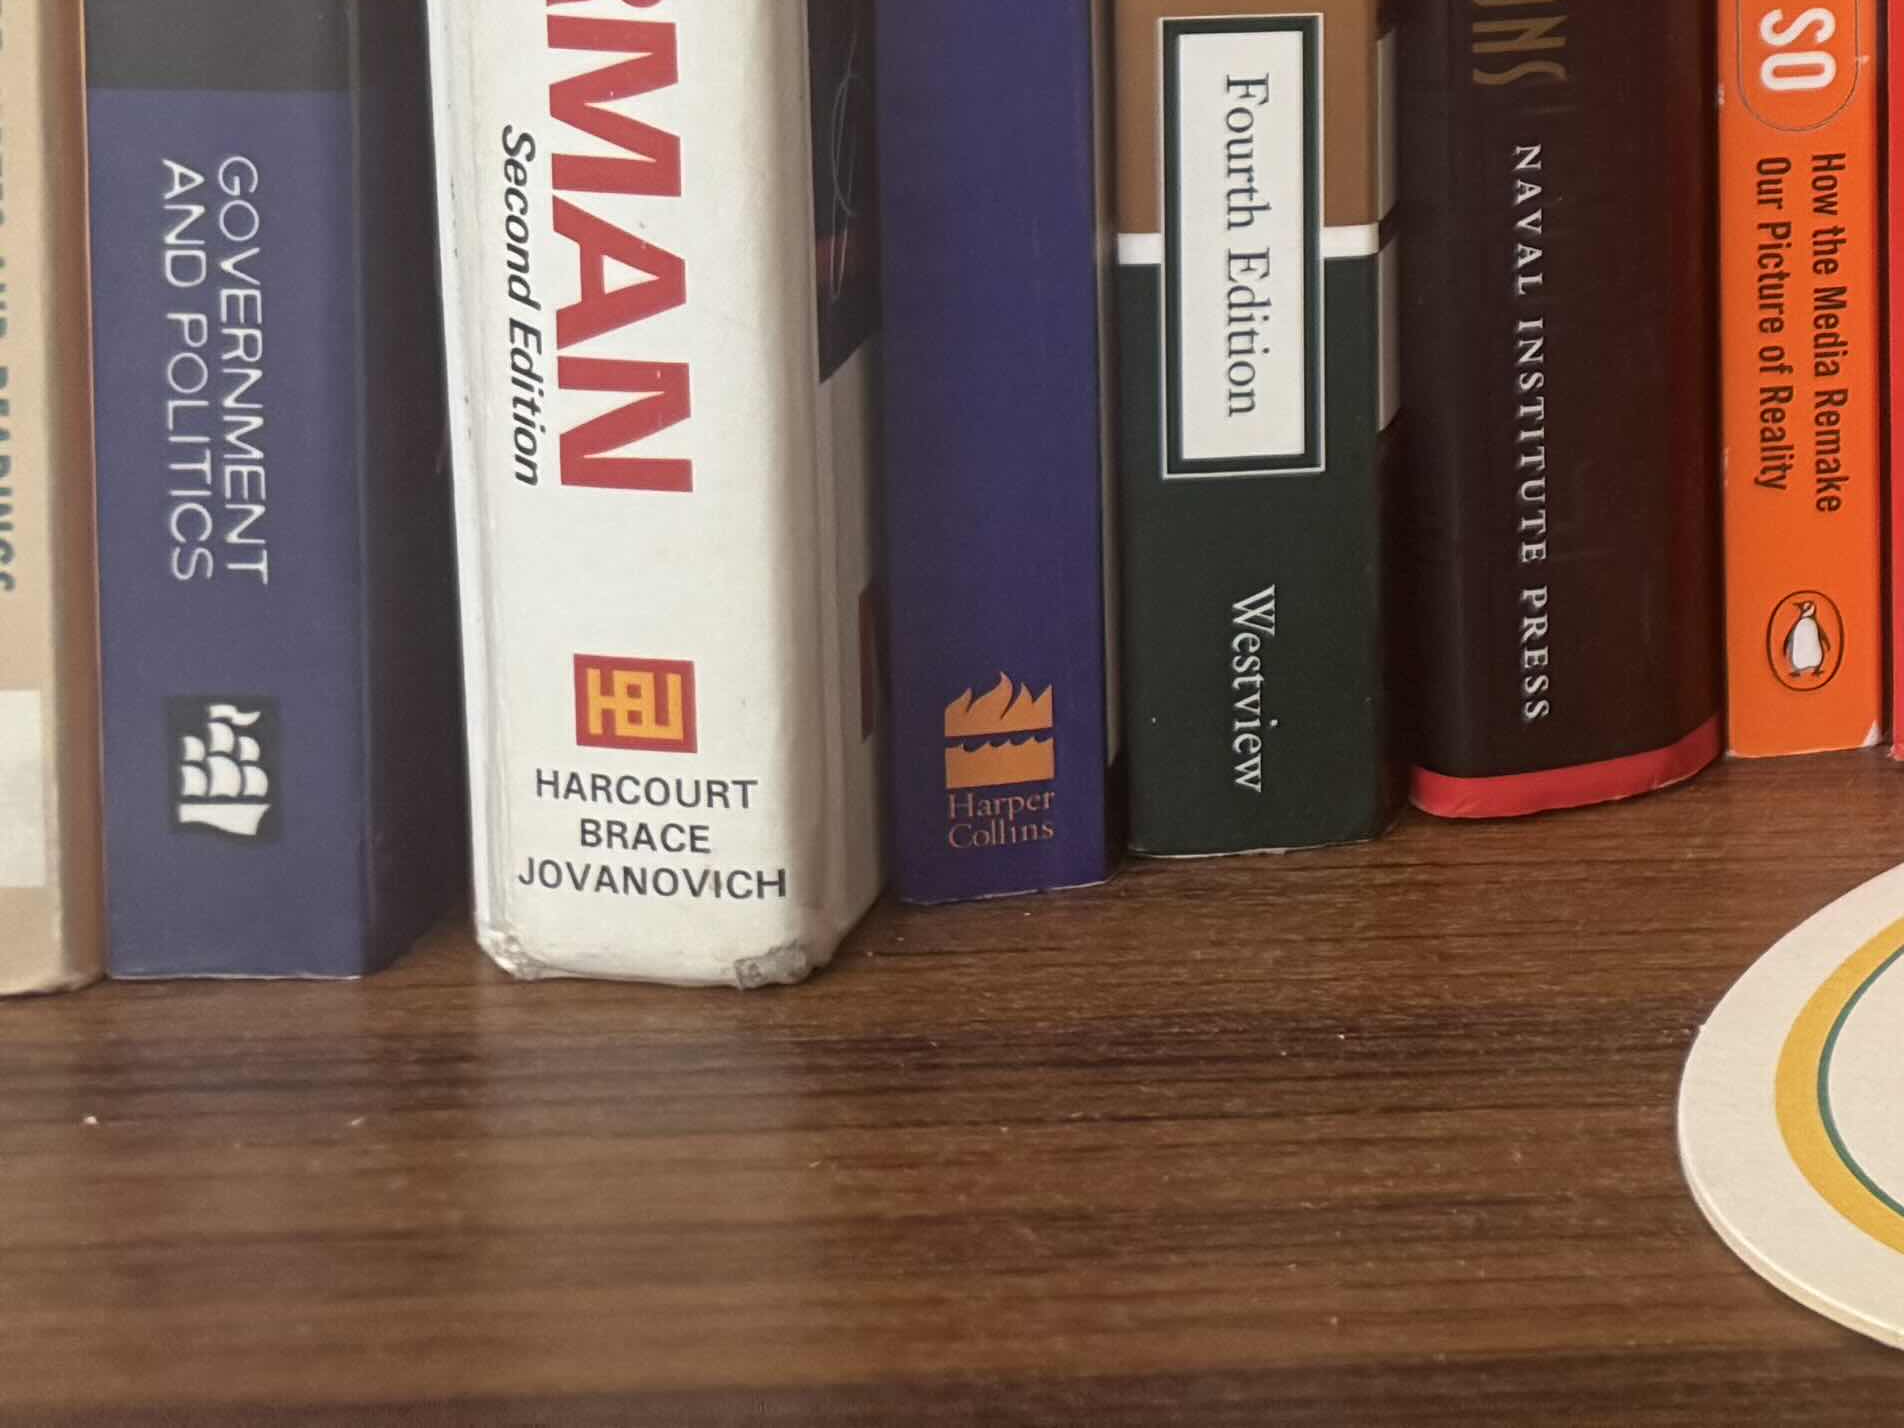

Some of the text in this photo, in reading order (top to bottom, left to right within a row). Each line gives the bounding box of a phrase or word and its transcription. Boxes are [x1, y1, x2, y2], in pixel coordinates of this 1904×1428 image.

[1758, 8, 1837, 93] SO
[161, 158, 215, 583] AND POLITICS
[217, 154, 269, 586] GOVERNMENT
[1754, 156, 1794, 493] Our Picture of Reality
[1811, 151, 1850, 514] How the Media Remake
[1511, 143, 1552, 724] NAVAL INSTITUTE PRESS
[1232, 583, 1277, 794] Westview
[534, 767, 759, 812] HARCOURT
[578, 816, 711, 855] BRACE
[947, 787, 1056, 822] Harper
[947, 816, 1055, 849] Collins
[516, 856, 788, 901] JOVANOVICH
